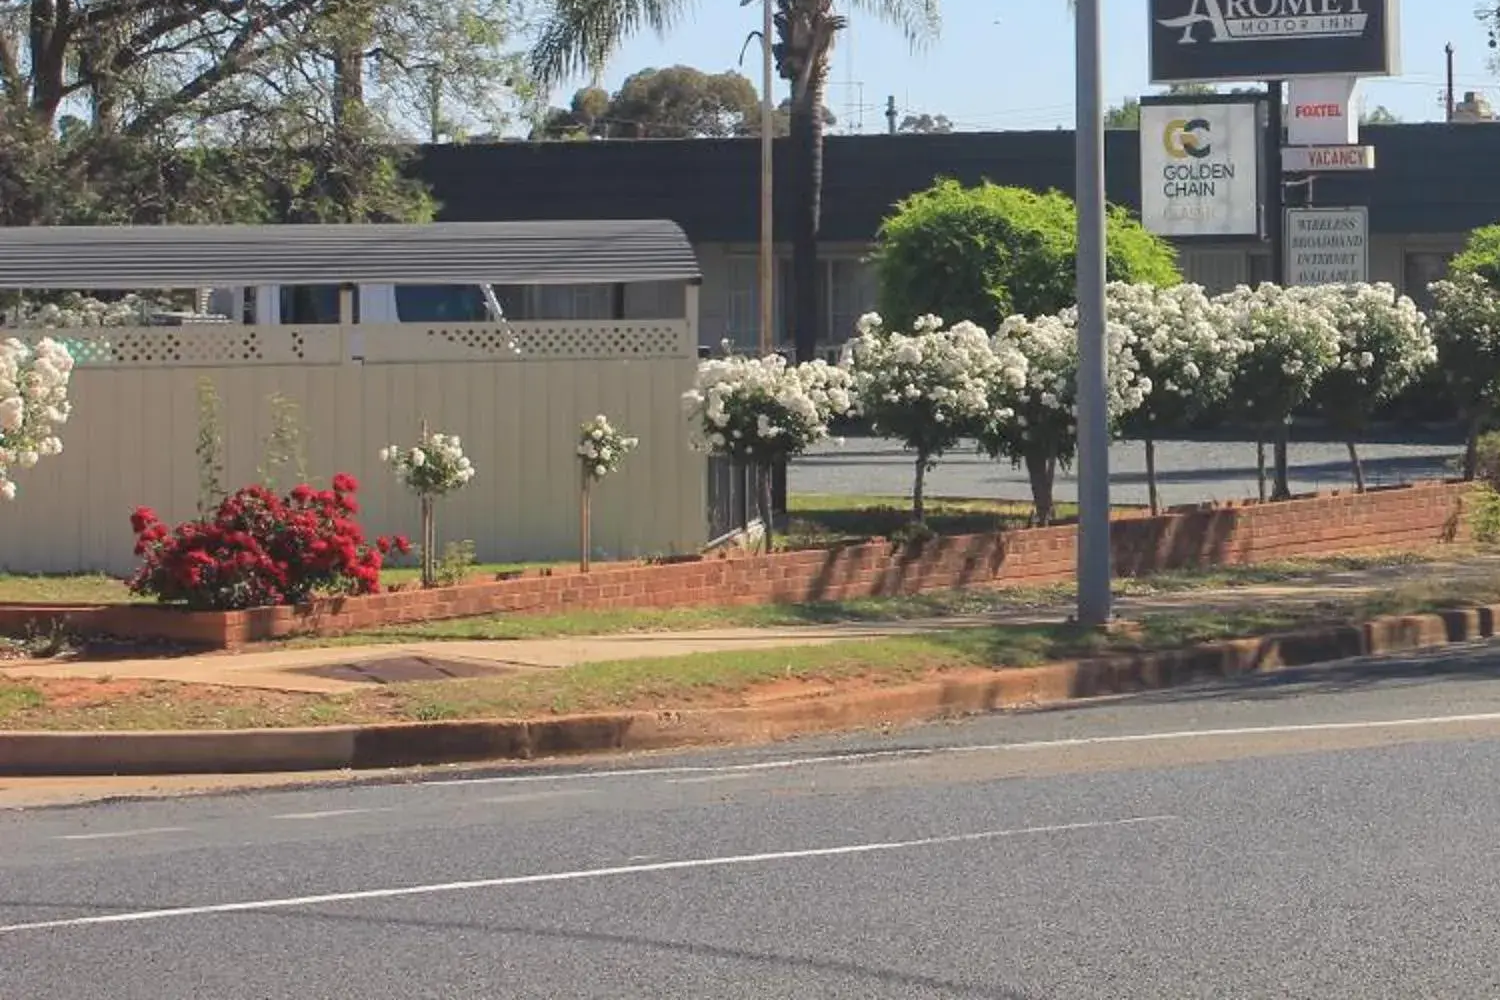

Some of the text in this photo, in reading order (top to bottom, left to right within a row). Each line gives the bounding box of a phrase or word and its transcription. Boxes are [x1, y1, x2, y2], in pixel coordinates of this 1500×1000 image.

[1240, 16, 1354, 33] MOTOR INN
[1295, 103, 1343, 118] FOXTEL
[1308, 150, 1365, 167] VACANCY
[1163, 163, 1235, 180] GOLDEN
[1163, 181, 1216, 198] CHAIN
[1297, 217, 1357, 231] WIRELESS
[1291, 235, 1363, 249] BROADBAND
[1296, 252, 1358, 266] INTERNET
